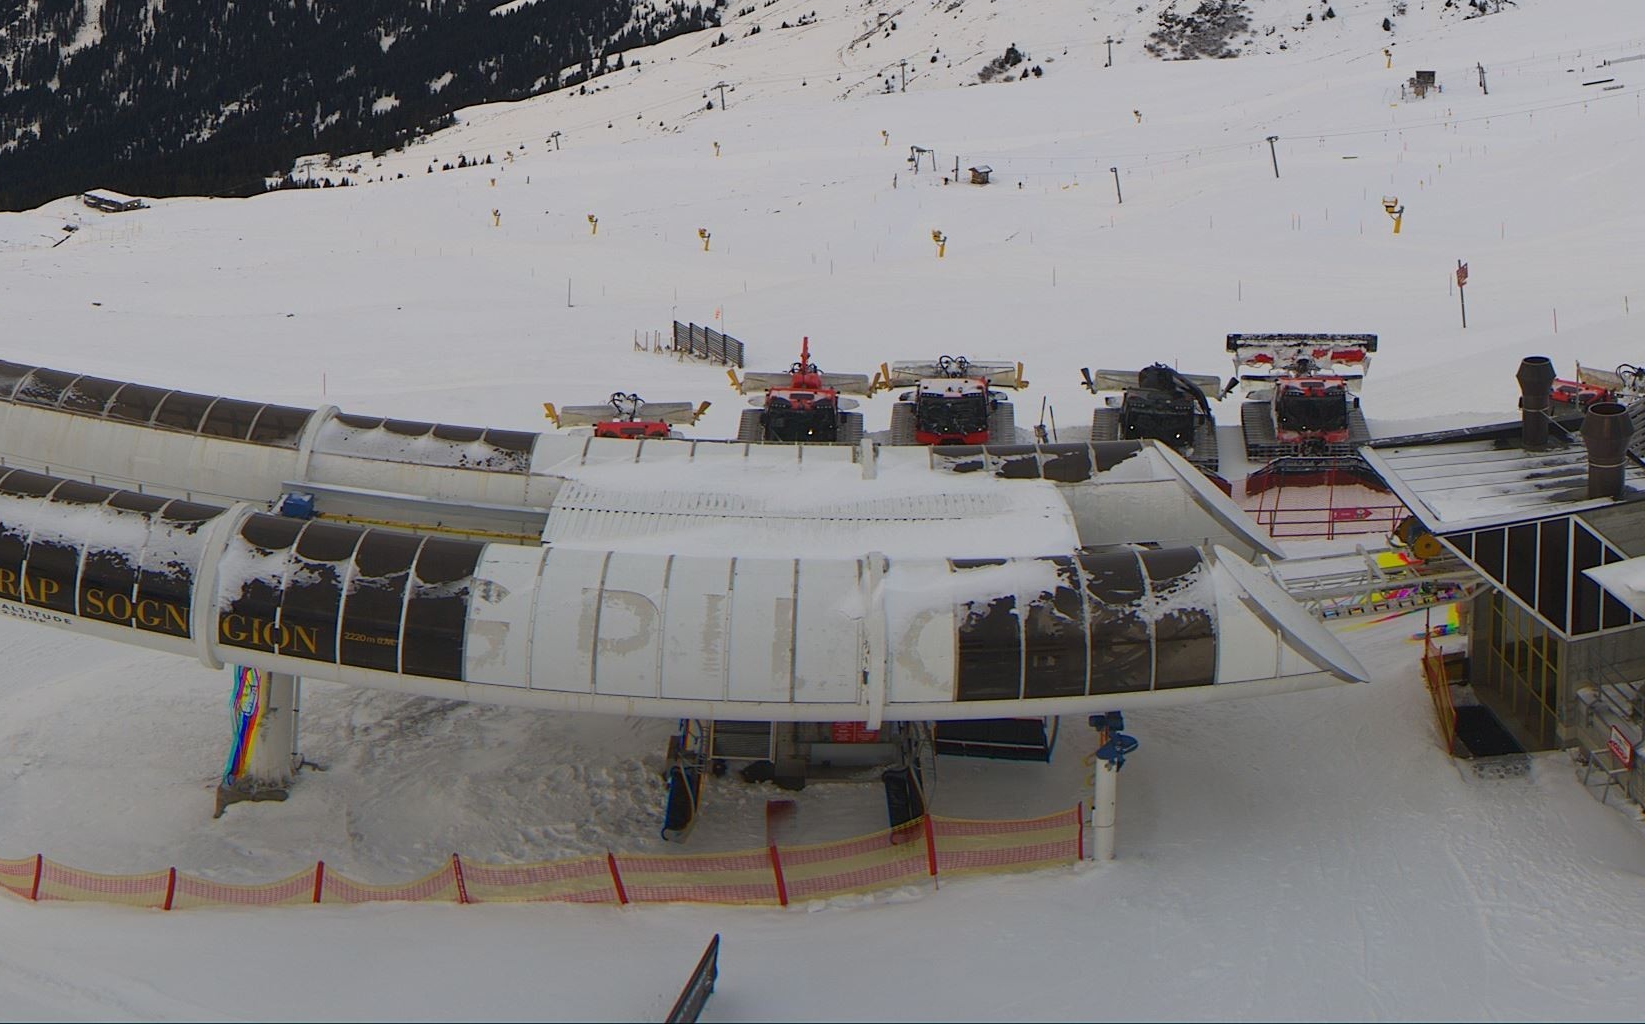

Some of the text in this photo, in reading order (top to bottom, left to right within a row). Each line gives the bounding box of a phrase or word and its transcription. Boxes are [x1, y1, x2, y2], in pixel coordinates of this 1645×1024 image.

[2, 603, 72, 625] ALTITUDE
[86, 588, 190, 632] SOGN
[222, 613, 319, 655] GION
